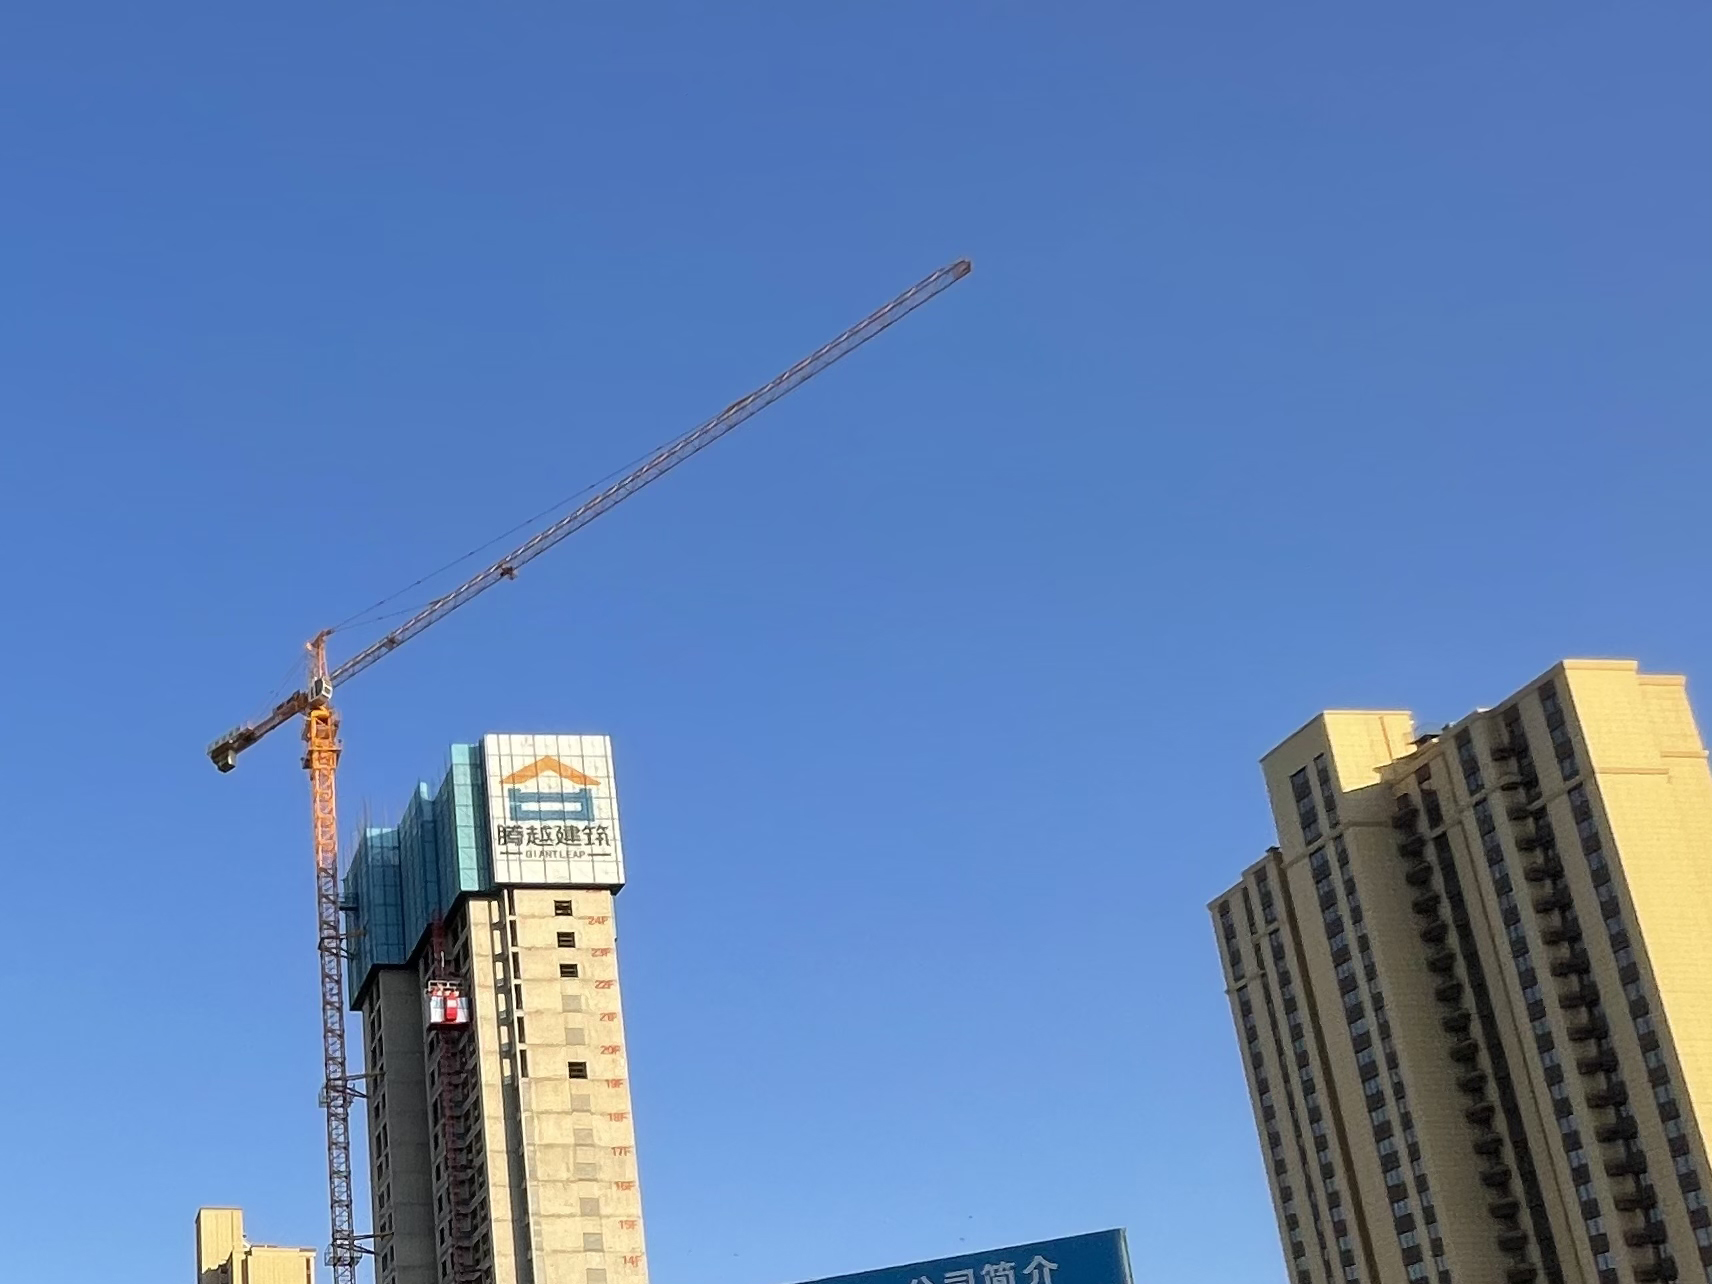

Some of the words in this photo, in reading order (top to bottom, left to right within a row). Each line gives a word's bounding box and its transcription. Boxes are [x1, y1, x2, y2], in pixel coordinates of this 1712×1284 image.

[497, 824, 611, 847] 腾越建筑
[622, 1256, 642, 1267] 14F
